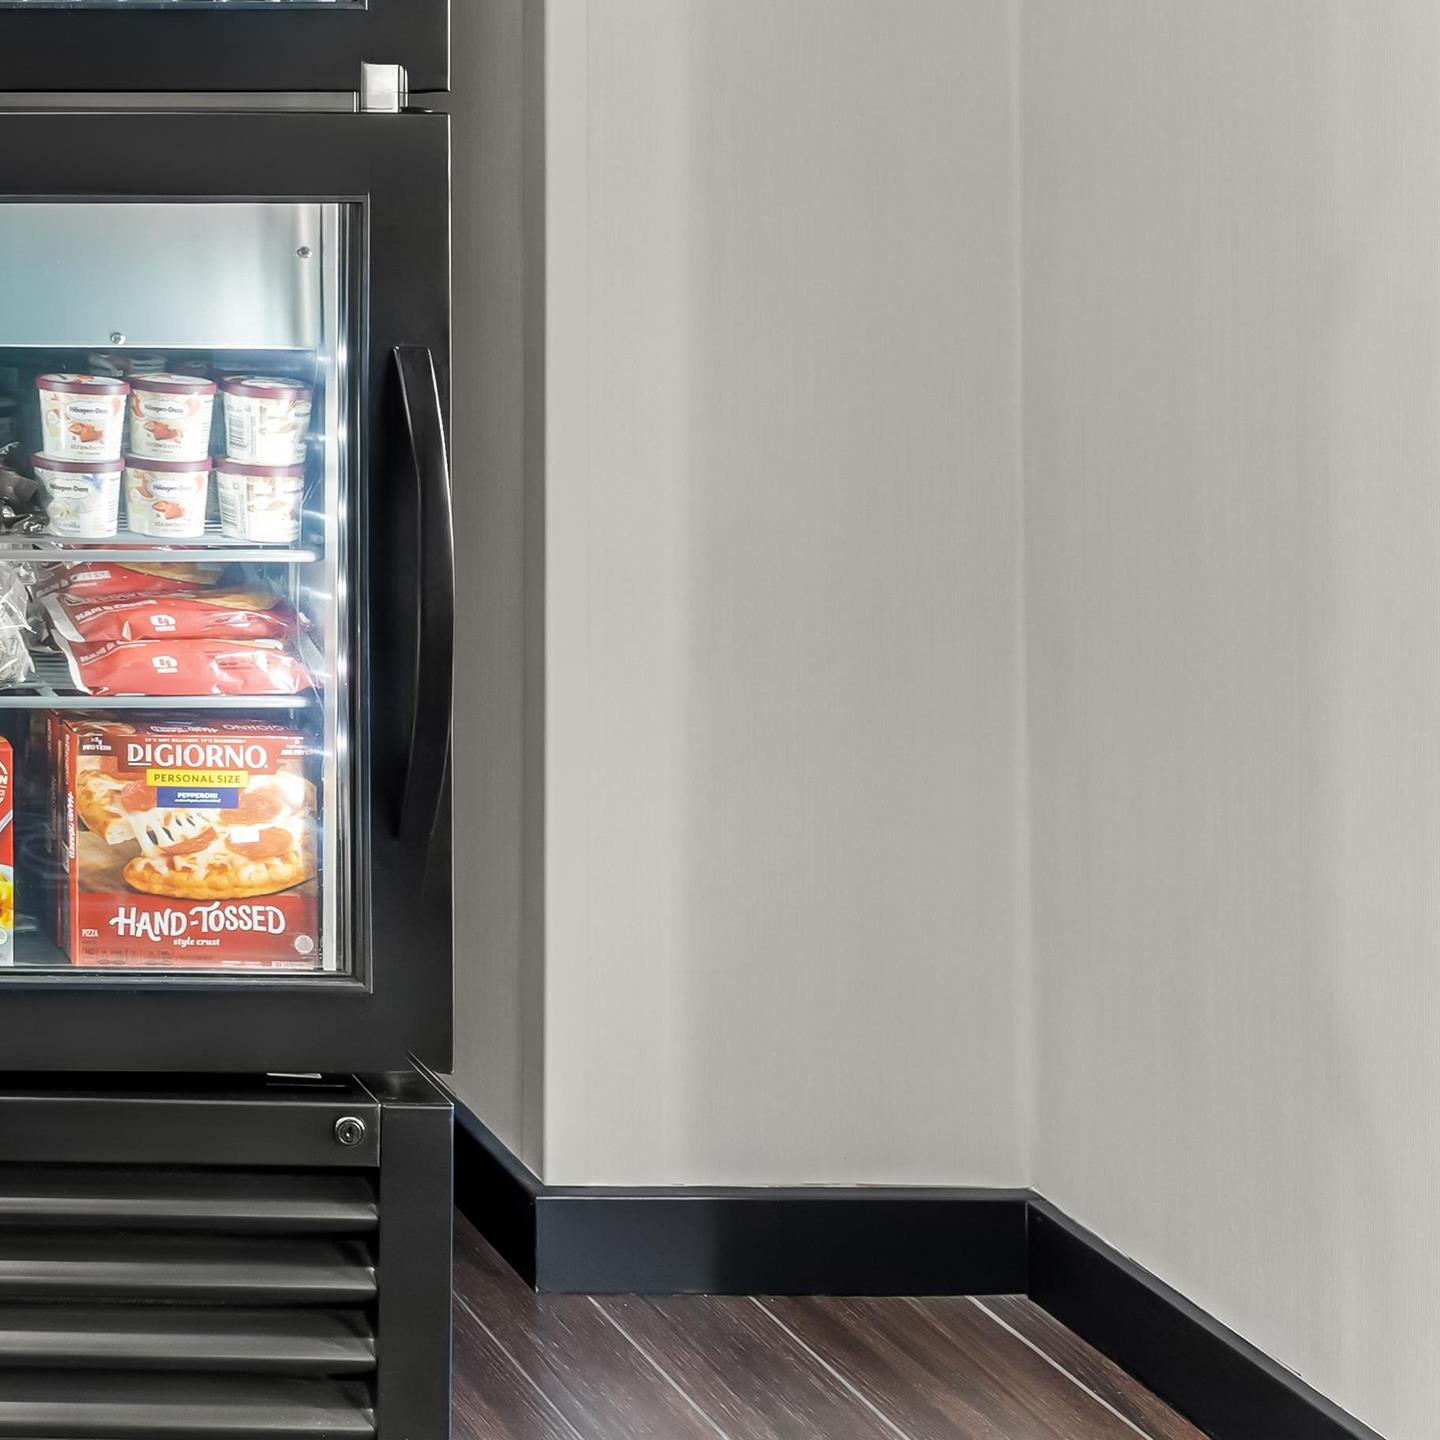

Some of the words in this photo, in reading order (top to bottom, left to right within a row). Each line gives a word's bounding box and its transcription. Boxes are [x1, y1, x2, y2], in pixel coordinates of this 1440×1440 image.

[154, 773, 215, 783] PERSONAL
[217, 775, 240, 783] SIZE
[109, 901, 286, 941] HAND-TOSSED
[173, 938, 195, 947] style
[197, 938, 220, 946] crust
